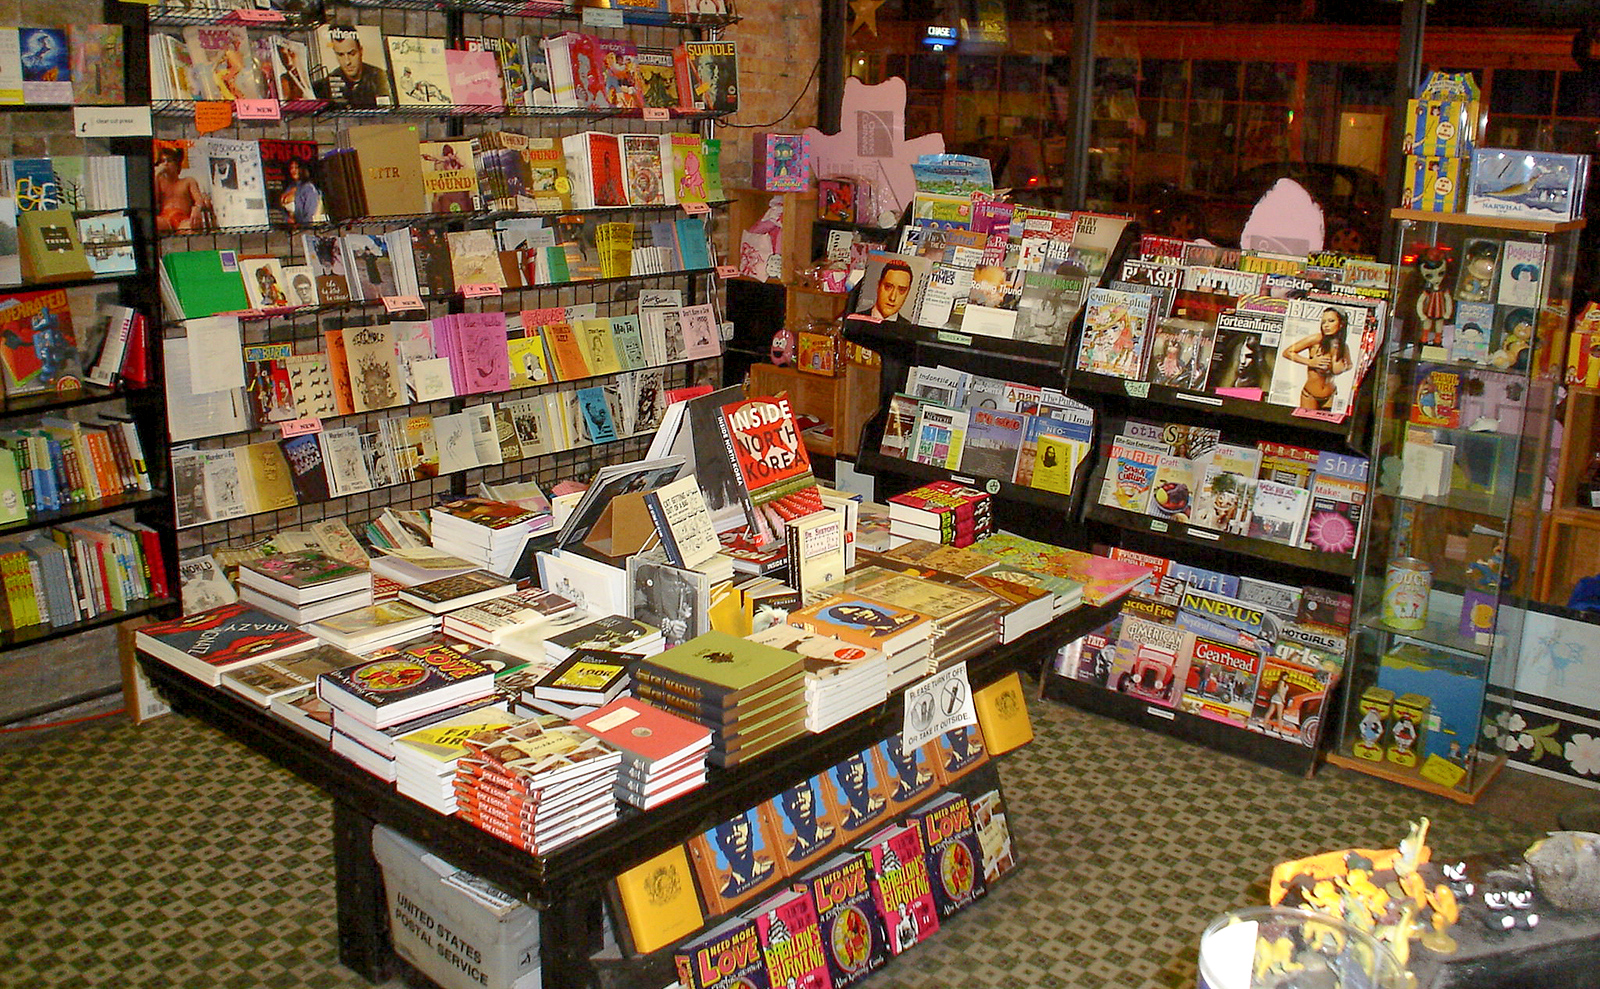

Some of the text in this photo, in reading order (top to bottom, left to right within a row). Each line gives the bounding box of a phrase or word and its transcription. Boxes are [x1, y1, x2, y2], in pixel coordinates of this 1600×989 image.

[928, 27, 951, 36] CHASE
[687, 43, 735, 57] SWINDLE
[260, 143, 312, 160] SPREAD
[1482, 202, 1523, 211] NARWHAL
[1076, 225, 1097, 235] FREE!
[1078, 216, 1098, 226] STAY
[1047, 250, 1070, 260] FREE!
[1049, 241, 1071, 252] STAY
[1122, 266, 1177, 288] FASH
[1245, 256, 1298, 276] TATTOO
[931, 273, 955, 285] TIMES
[1196, 269, 1253, 294] TATTOOS
[728, 400, 792, 433] INSIDE
[717, 416, 743, 486] INSIDE NORTH KOREA
[737, 424, 797, 457] NORTH
[745, 449, 806, 481] KOREA
[1124, 464, 1147, 477] Snack
[1118, 472, 1147, 484] Culture
[1315, 486, 1341, 499] Make:
[181, 562, 213, 576] WORLD
[1117, 550, 1164, 565] PROCESSED
[1177, 570, 1228, 595] shift
[1155, 604, 1175, 620] Fire
[224, 622, 290, 633] KRAZY
[1127, 621, 1185, 643] AMERICAN
[1087, 634, 1106, 649] FATE
[407, 644, 479, 679] LOVE
[462, 657, 487, 672] MORE
[1196, 643, 1255, 672] Gearhead
[579, 667, 614, 678] LOOK
[909, 684, 931, 700] PLEASE
[931, 677, 945, 689] TURN
[951, 666, 966, 677] OFF!
[908, 735, 918, 744] OR
[919, 729, 933, 741] TAKE
[940, 712, 971, 730] OUTSIDE.
[933, 797, 968, 823] NEED MORE
[925, 806, 972, 846] LOVE
[824, 859, 864, 886] NEED MORE
[878, 854, 926, 896] BABYLON'S
[814, 866, 869, 914] LOVE
[883, 873, 930, 914] BURNING
[397, 892, 482, 964] UNITED STATES
[395, 908, 489, 987] POSTAL SERVICE
[709, 926, 756, 958] NEED MORE
[765, 924, 821, 968] BABYLON'S
[697, 934, 761, 988] LOVE
[771, 944, 826, 989] BURNING
